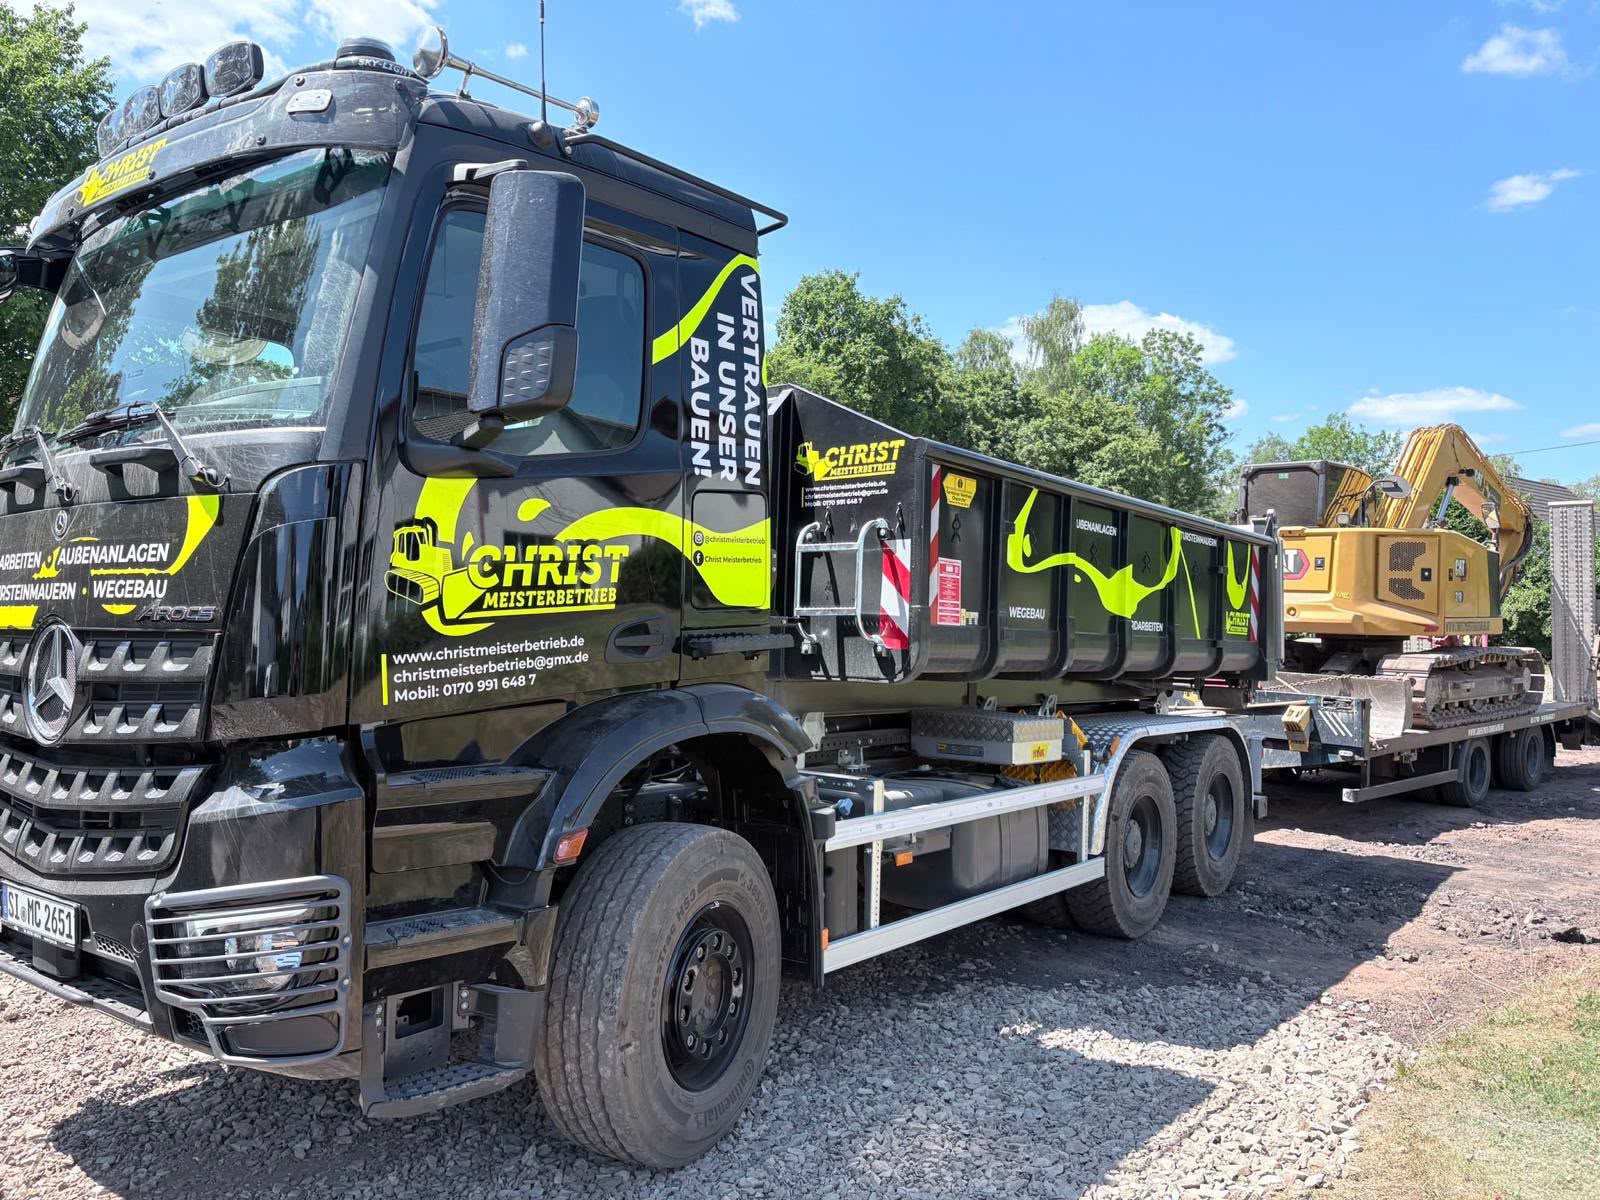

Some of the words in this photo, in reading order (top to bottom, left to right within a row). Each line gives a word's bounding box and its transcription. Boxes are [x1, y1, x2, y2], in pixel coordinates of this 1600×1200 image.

[358, 58, 413, 77] SKY-LIGHT
[716, 312, 735, 351] IN
[741, 274, 761, 486] VERTRAUEN
[690, 337, 712, 479] BAUEN!
[718, 360, 737, 482] UNSER
[824, 439, 905, 468] CHRIST
[830, 462, 896, 476] MEISTERBETRIEB
[805, 480, 887, 492] www.christmeisterbetrieb.de
[805, 488, 888, 500] christmeisterbetrieb@gmx.de
[705, 536, 766, 545] @christmeisterbetrieb
[0, 551, 42, 570] ARBEITEN
[57, 543, 170, 566] AUßENANLAGEN
[467, 544, 630, 589] CHRIST
[705, 555, 722, 563] Christ
[723, 556, 763, 564] Meisterbetrieb
[0, 582, 77, 601] RSTEINMAUERN
[93, 580, 168, 600] WEGEBAU
[482, 587, 617, 609] MEISTERBETRIEB
[1009, 606, 1045, 620] WEGEBAU
[393, 635, 585, 665] www.christmeisterbetrieb.de
[393, 651, 589, 683] christmeisterbetrieb@gmx.de
[394, 685, 440, 702] Mobil:
[442, 682, 474, 697] 0170
[477, 678, 499, 692] 991
[502, 675, 526, 689] 648
[528, 673, 537, 686] 7
[8, 891, 20, 920] SI
[27, 897, 42, 928] MC
[44, 904, 73, 940] 2651
[703, 1058, 755, 1129] Continental
